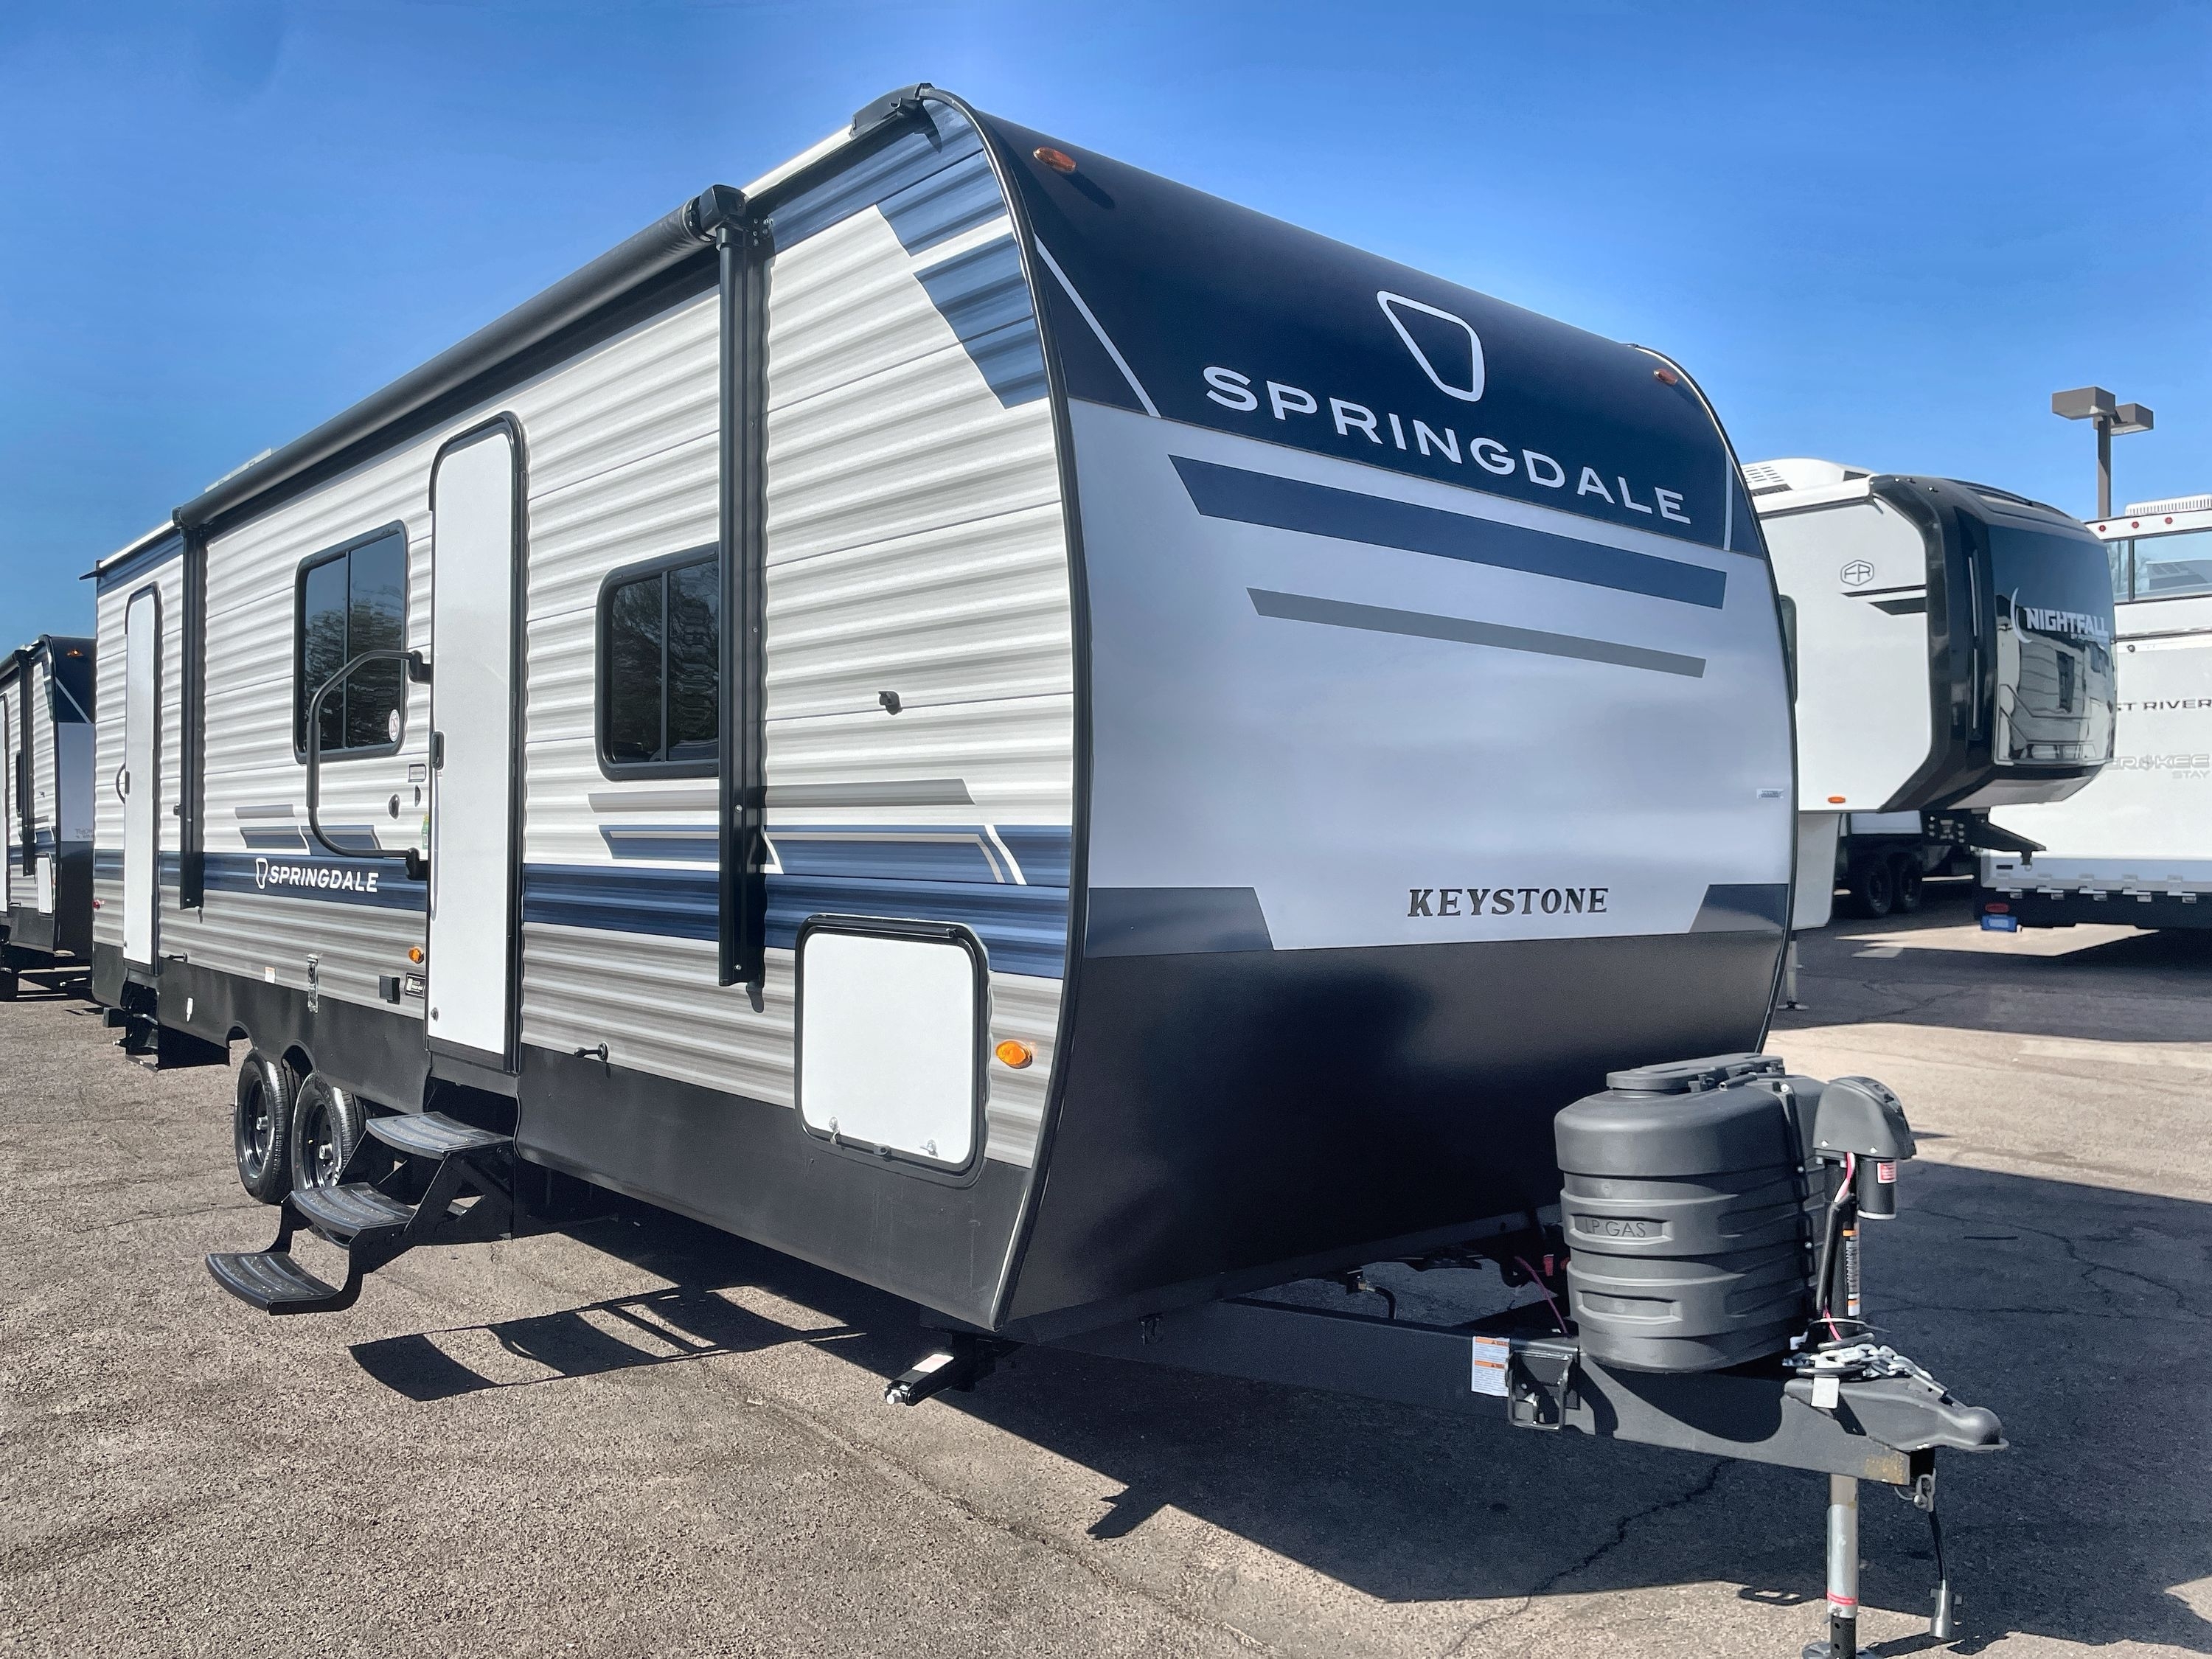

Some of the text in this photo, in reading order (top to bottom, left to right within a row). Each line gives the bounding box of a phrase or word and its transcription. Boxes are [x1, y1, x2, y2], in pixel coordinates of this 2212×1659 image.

[1203, 366, 1691, 525] SPRINGDALE
[2023, 608, 2110, 636] NIGHTFALL
[2143, 699, 2212, 711] RIVER
[268, 865, 380, 893] SPRINGDALE
[1407, 888, 1609, 917] KEYSTONE
[1585, 1217, 1646, 1238] LP GAS
